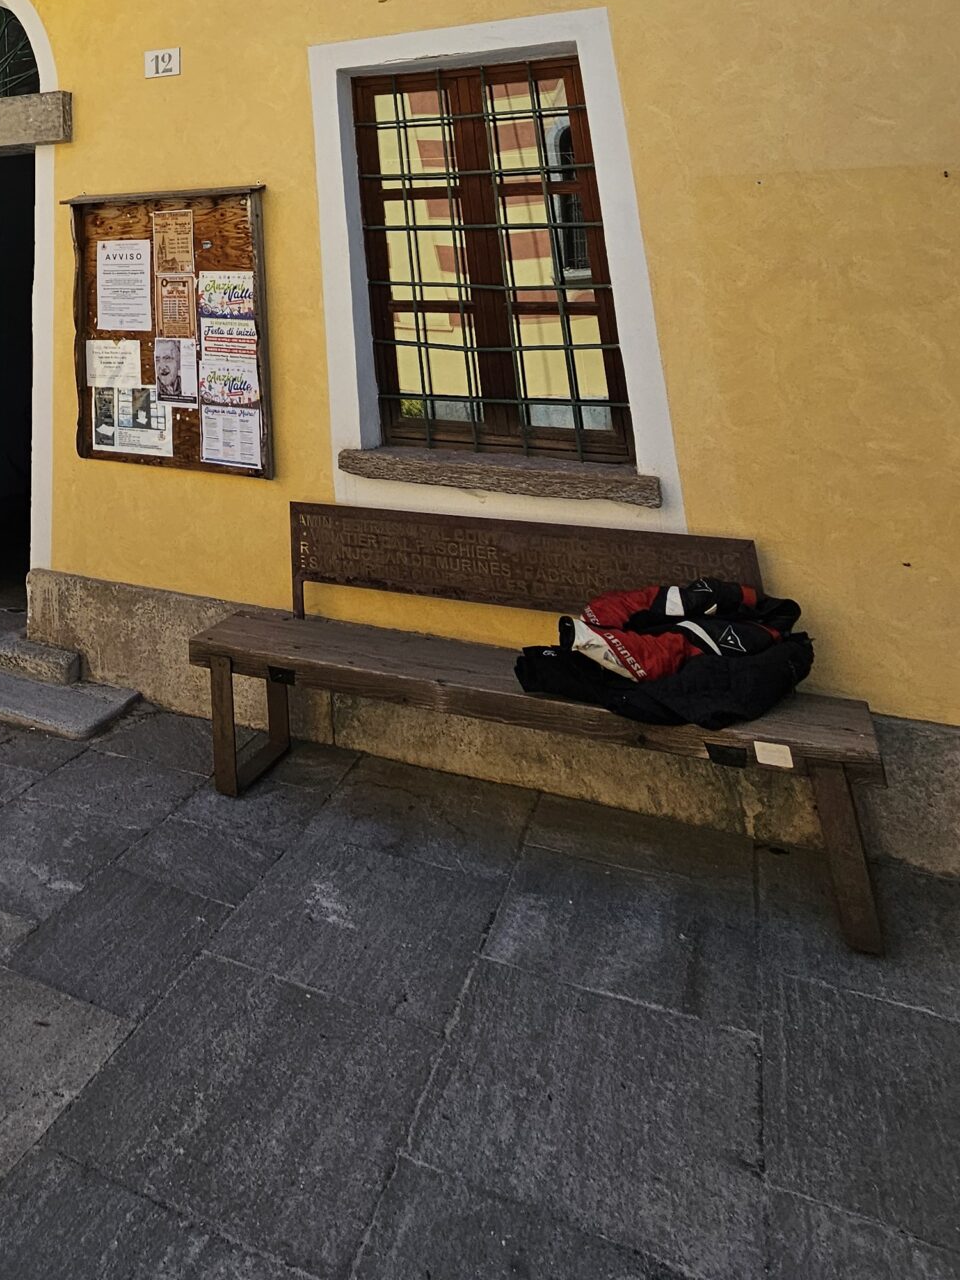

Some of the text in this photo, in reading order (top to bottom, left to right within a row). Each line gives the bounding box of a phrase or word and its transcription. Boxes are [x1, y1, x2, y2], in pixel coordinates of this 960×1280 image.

[150, 53, 173, 74] 12
[105, 252, 142, 261] AVVISO
[223, 286, 254, 302] Valle
[204, 325, 225, 336] Festa
[226, 327, 235, 335] di
[224, 378, 252, 393] Valle
